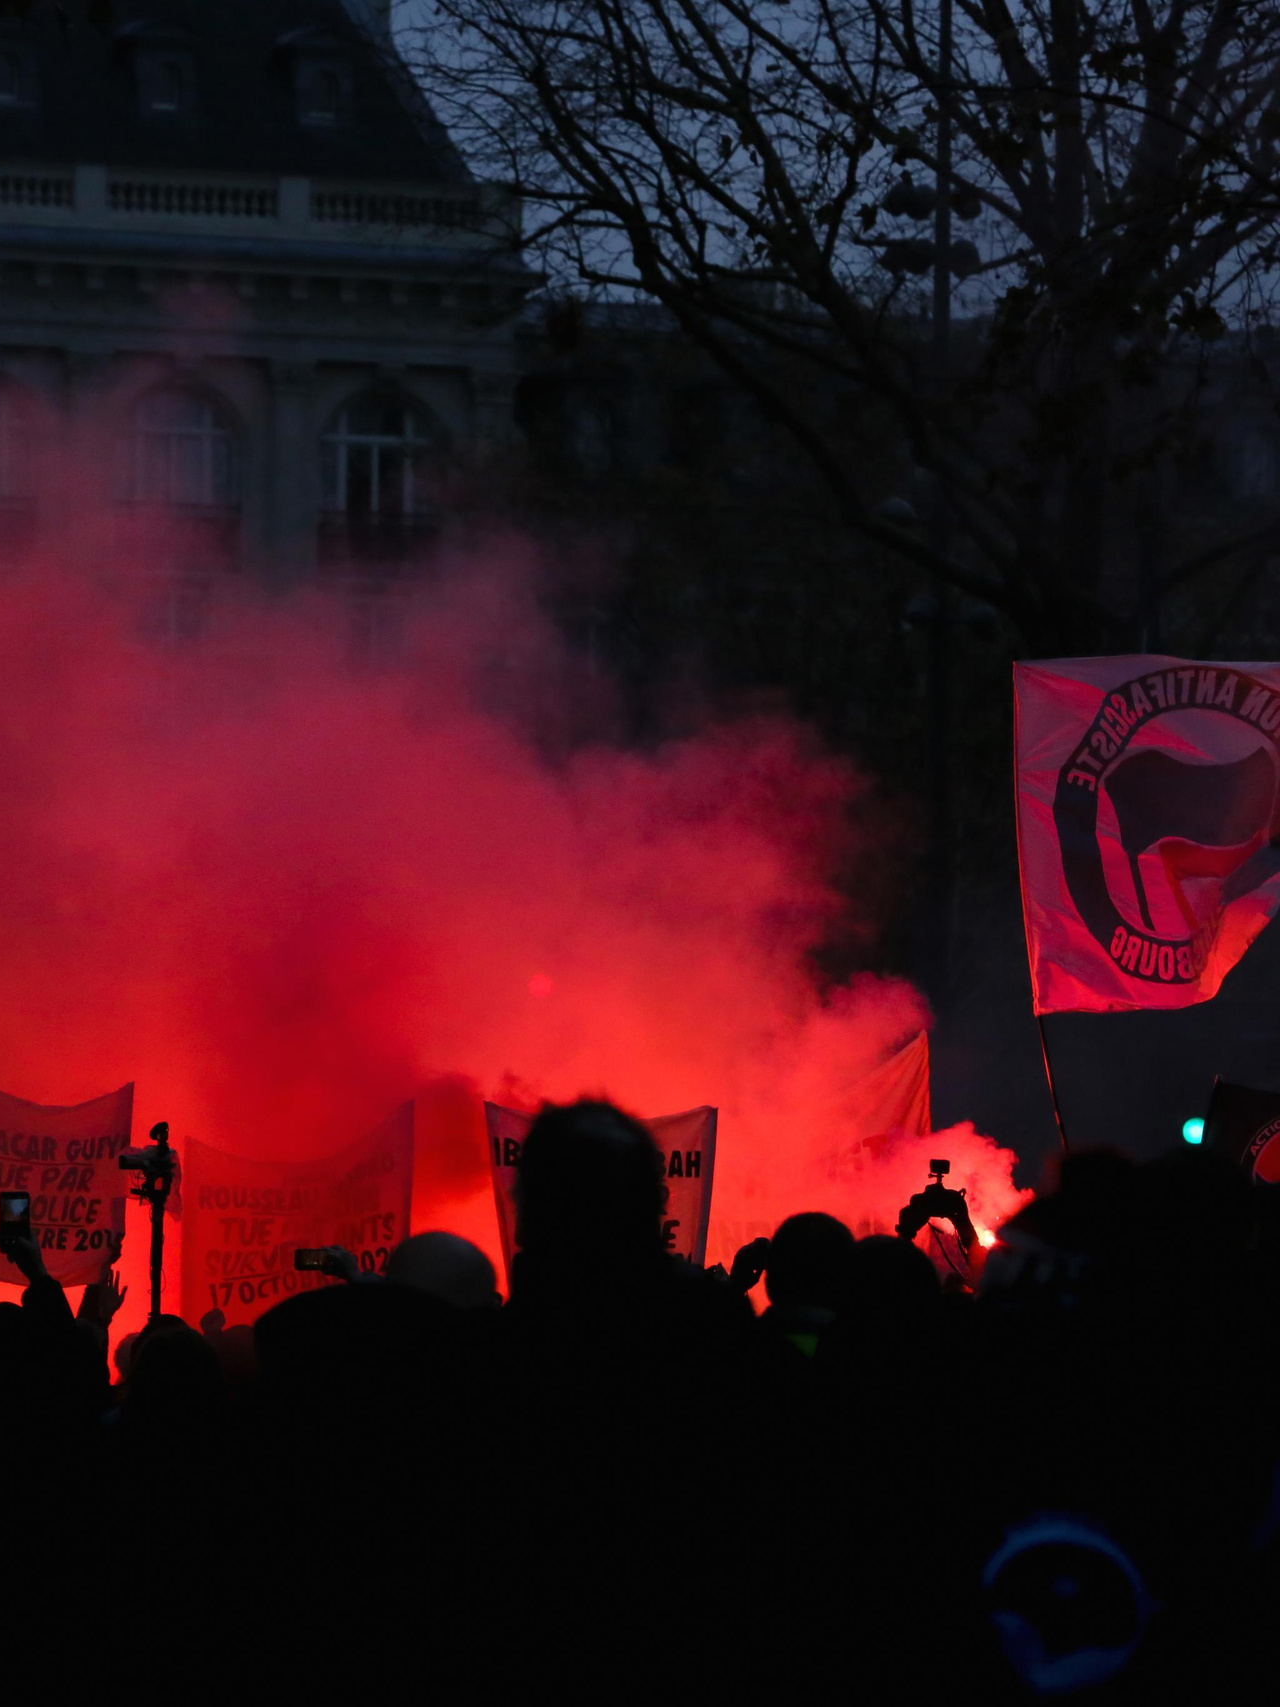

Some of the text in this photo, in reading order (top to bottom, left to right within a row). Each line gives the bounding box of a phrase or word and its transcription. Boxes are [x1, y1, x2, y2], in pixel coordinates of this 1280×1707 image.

[40, 1167, 95, 1193] PAR
[30, 1195, 102, 1225] OLICE
[74, 1228, 122, 1251] 201
[208, 1280, 233, 1308] 17
